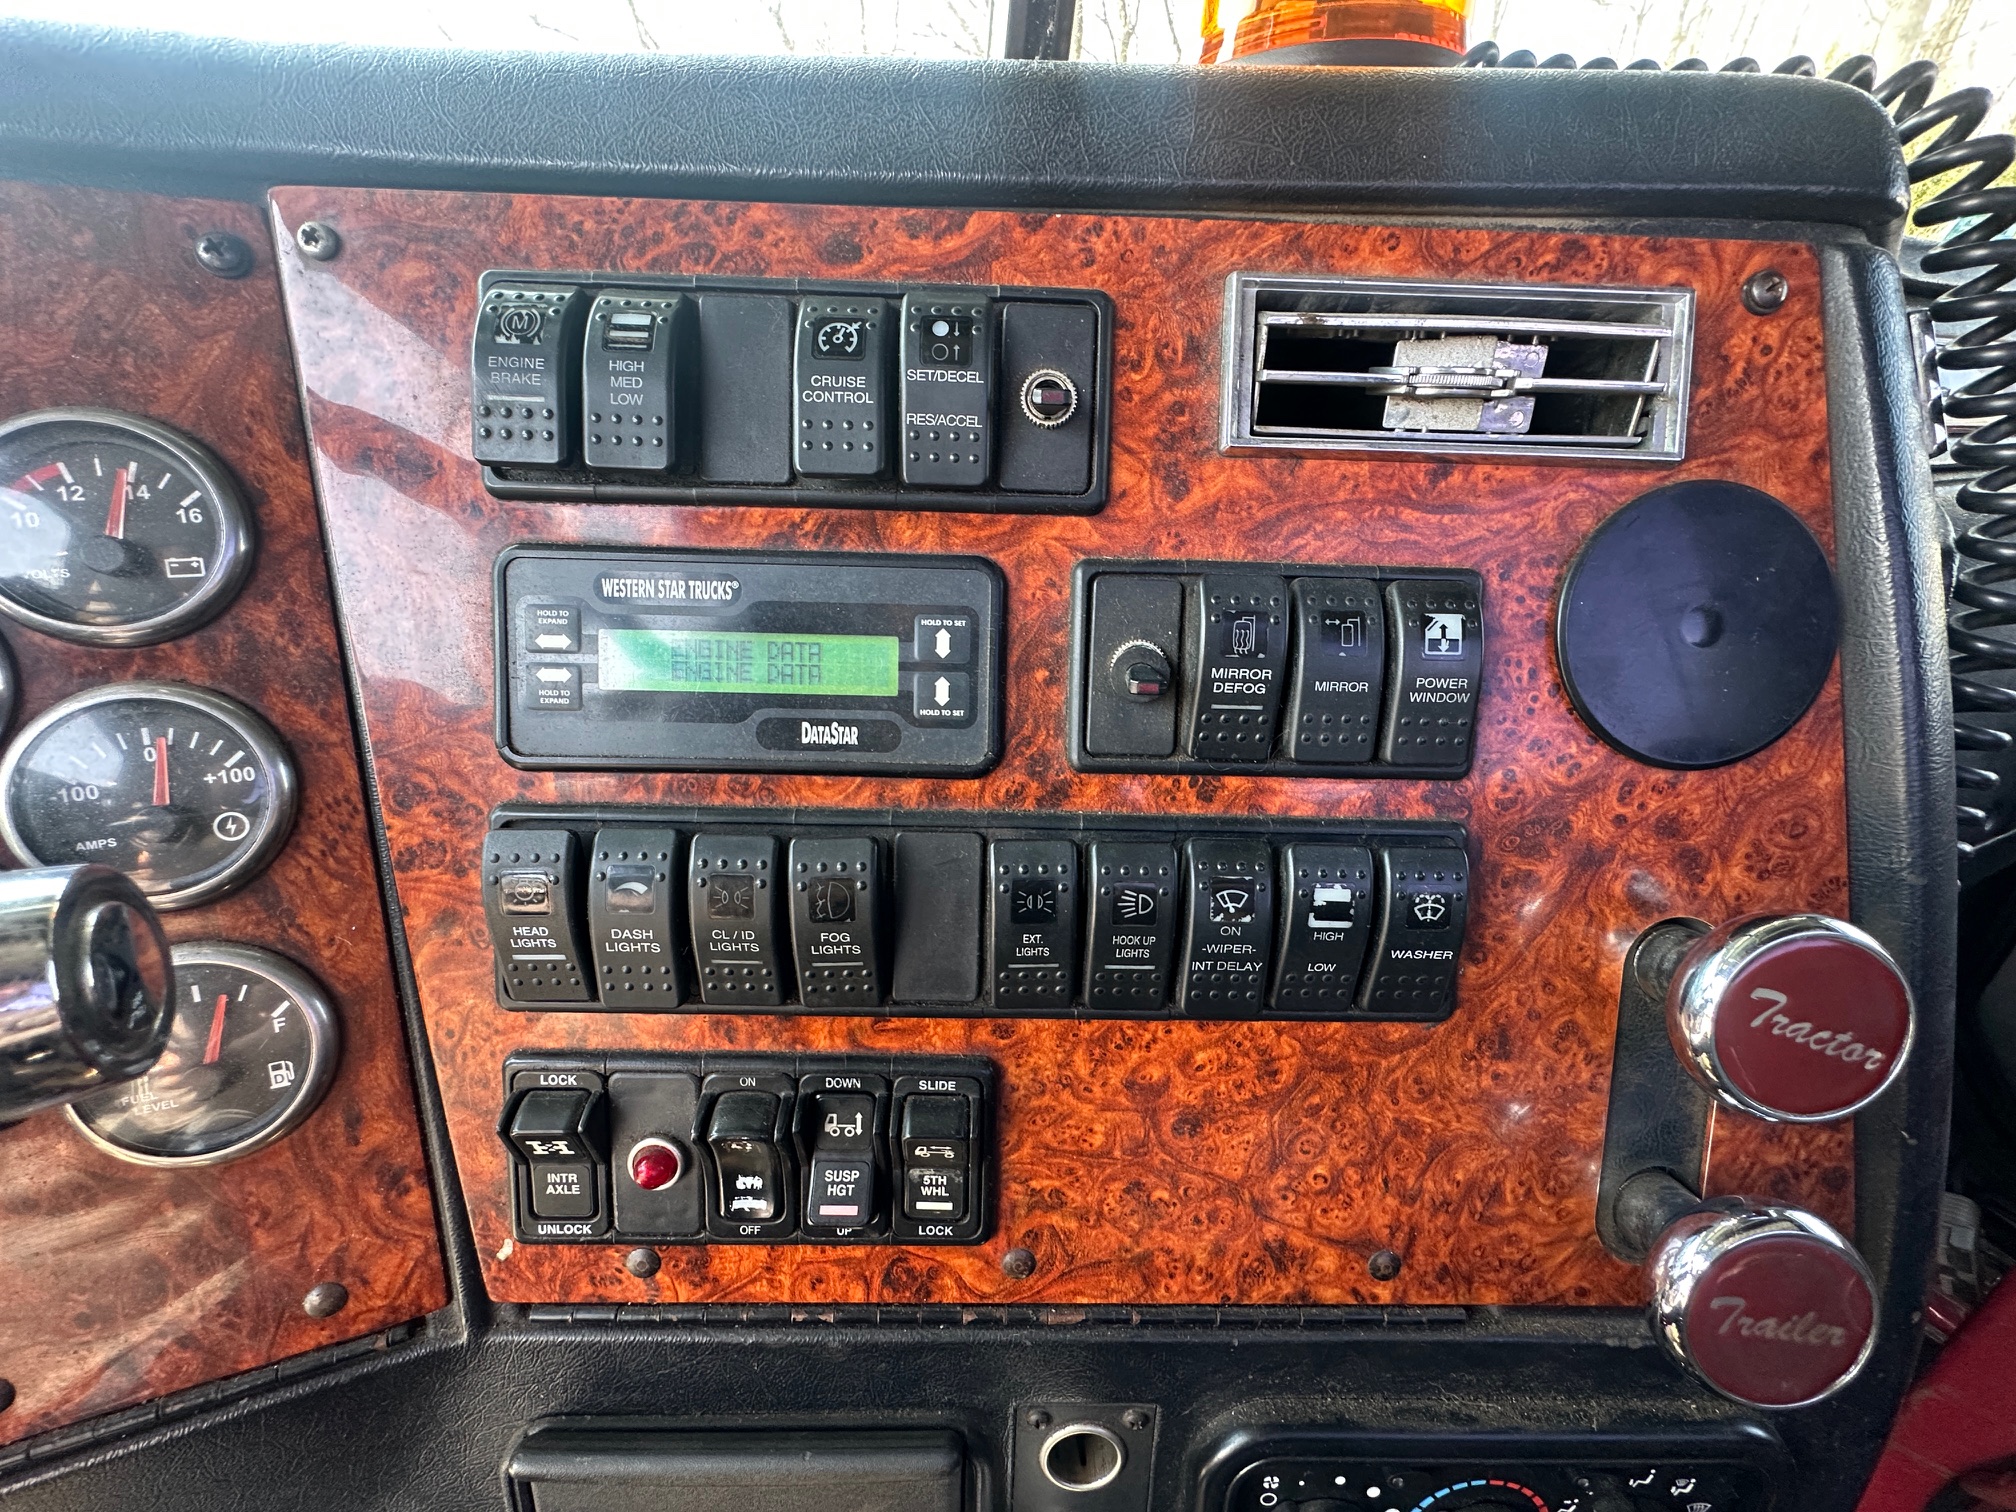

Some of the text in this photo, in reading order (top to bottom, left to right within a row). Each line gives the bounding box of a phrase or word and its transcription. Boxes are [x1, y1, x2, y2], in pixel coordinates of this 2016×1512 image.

[488, 356, 545, 370] ENGINE
[609, 360, 644, 372] HIGH
[491, 371, 541, 386] BRAKE
[610, 376, 643, 389] MED
[810, 375, 866, 388] CRUISE
[906, 369, 984, 384] SET/DECEL
[610, 393, 644, 406] LOW
[802, 390, 874, 404] CONTROL
[906, 413, 983, 428] RES/ACCEL
[56, 485, 85, 502] 12
[125, 484, 151, 500] 14
[10, 512, 39, 528] 10
[176, 508, 203, 524] 16
[601, 578, 654, 598] WESTERN
[658, 580, 686, 599] STAR
[1211, 667, 1272, 680] MIRROR
[1213, 682, 1266, 695] DEFOG
[1314, 680, 1369, 692] MIRROR
[1415, 677, 1468, 689] POWER
[1409, 692, 1470, 704] WINDOW
[143, 746, 156, 762] 0
[203, 766, 256, 784] +100
[75, 837, 117, 851] AMPS
[513, 926, 549, 937] HEAD
[611, 928, 653, 940] DASH
[711, 929, 730, 941] CL
[741, 930, 755, 941] ID
[820, 932, 850, 943] FOG
[1220, 926, 1241, 937] ON
[1313, 931, 1344, 942] HIGH
[510, 937, 557, 948] LIGHTS
[1022, 934, 1043, 945] EXT.
[1112, 935, 1156, 946] HOOK UP
[606, 941, 661, 953] LIGHTS
[709, 941, 759, 953] LIGHTS
[811, 944, 861, 955] LIGHTS
[1016, 946, 1050, 957] LIGHTS
[1115, 948, 1150, 958] LIGHTS
[1390, 949, 1453, 960] WASHER
[1191, 961, 1263, 972] INT DELAY
[1307, 963, 1336, 973] LOW
[273, 1017, 286, 1033] F
[1750, 987, 1886, 1070] Tractor
[540, 1075, 577, 1086] LOCK
[739, 1077, 756, 1087] ON
[825, 1078, 861, 1089] DOWN
[919, 1080, 956, 1091] SLIDE
[120, 1091, 158, 1106] FUEL
[132, 1099, 179, 1116] LEVEL
[547, 1173, 578, 1184] INTR
[825, 1170, 860, 1181] SUSP
[923, 1175, 947, 1186] 5TH
[546, 1184, 580, 1195] AXLE
[827, 1185, 855, 1196] HGT
[921, 1186, 949, 1197] WHL
[538, 1225, 592, 1235] UNLOCK
[739, 1225, 761, 1235] OFF
[836, 1227, 852, 1236] UP
[919, 1225, 953, 1236] LOCK
[1710, 1296, 1847, 1346] Trailer
